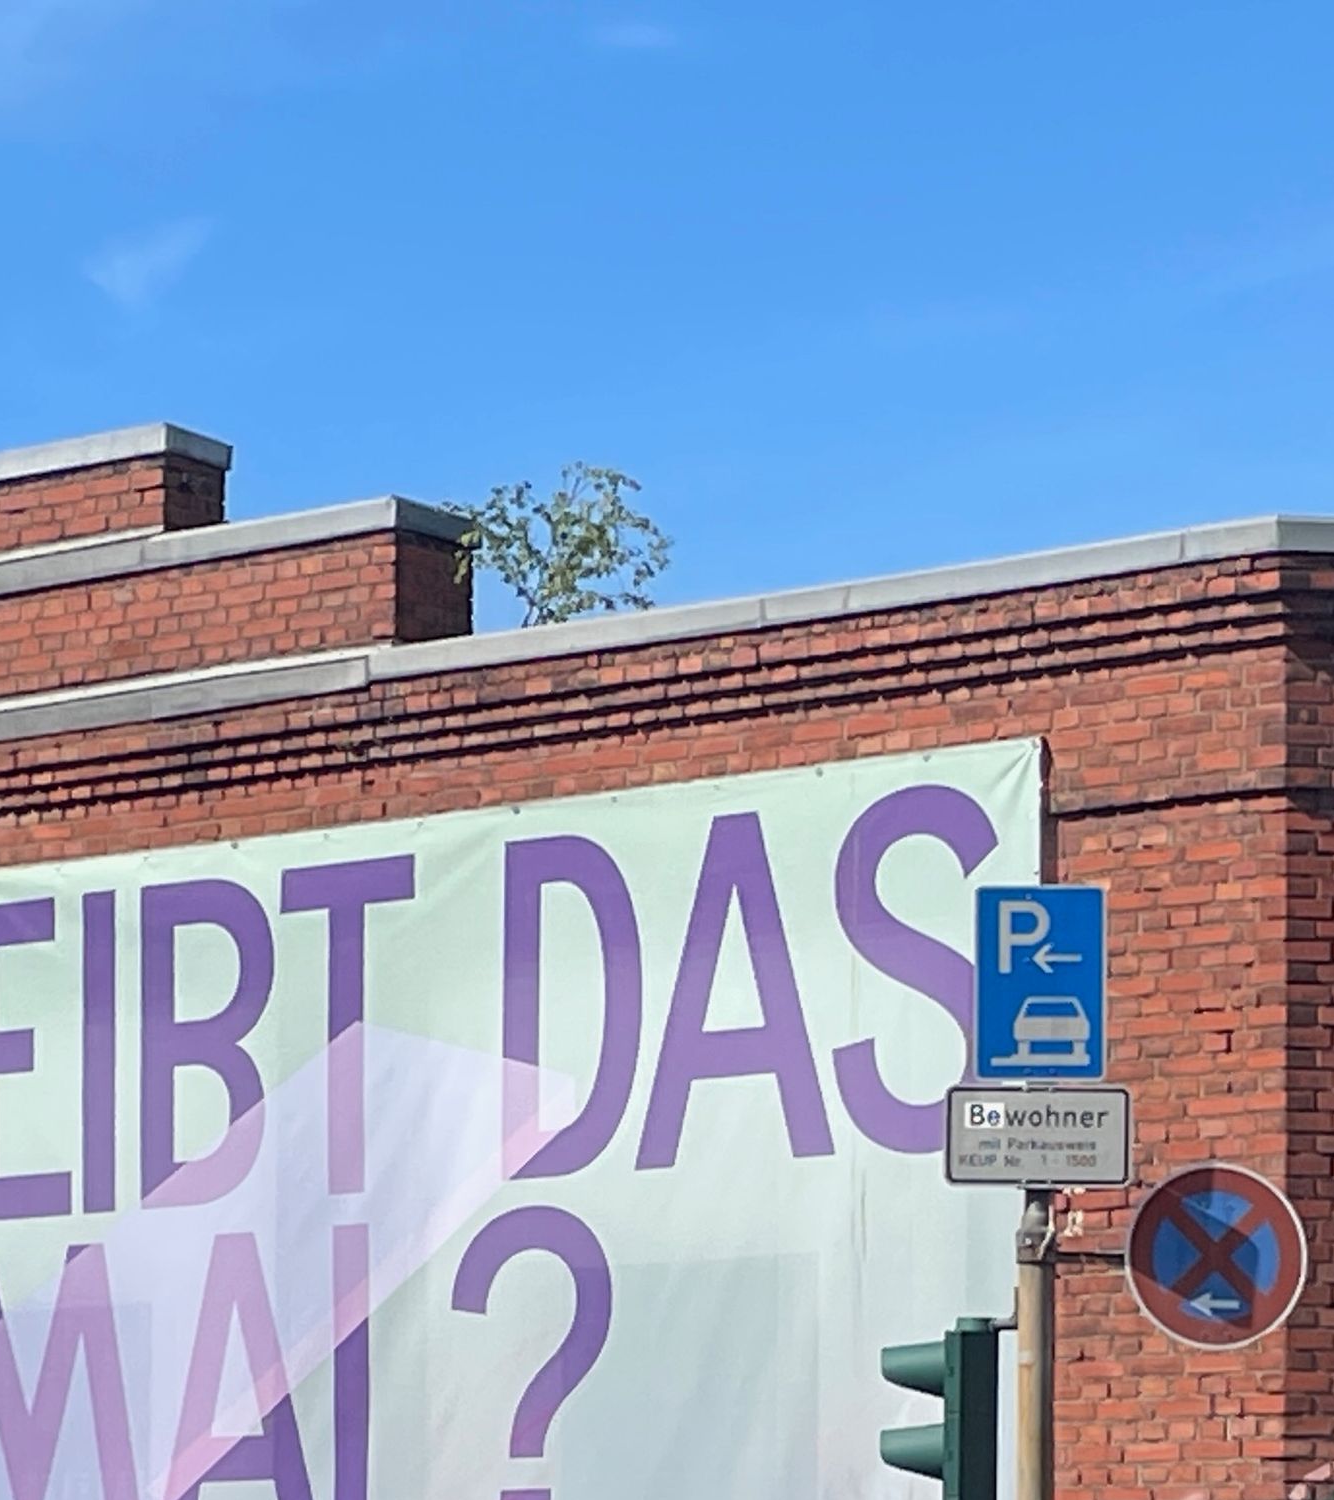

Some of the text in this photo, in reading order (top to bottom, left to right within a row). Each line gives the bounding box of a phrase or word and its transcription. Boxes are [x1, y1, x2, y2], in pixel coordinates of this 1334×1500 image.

[998, 900, 1051, 974] P
[501, 784, 999, 1181] DAS
[970, 1103, 1110, 1128] Bewohner
